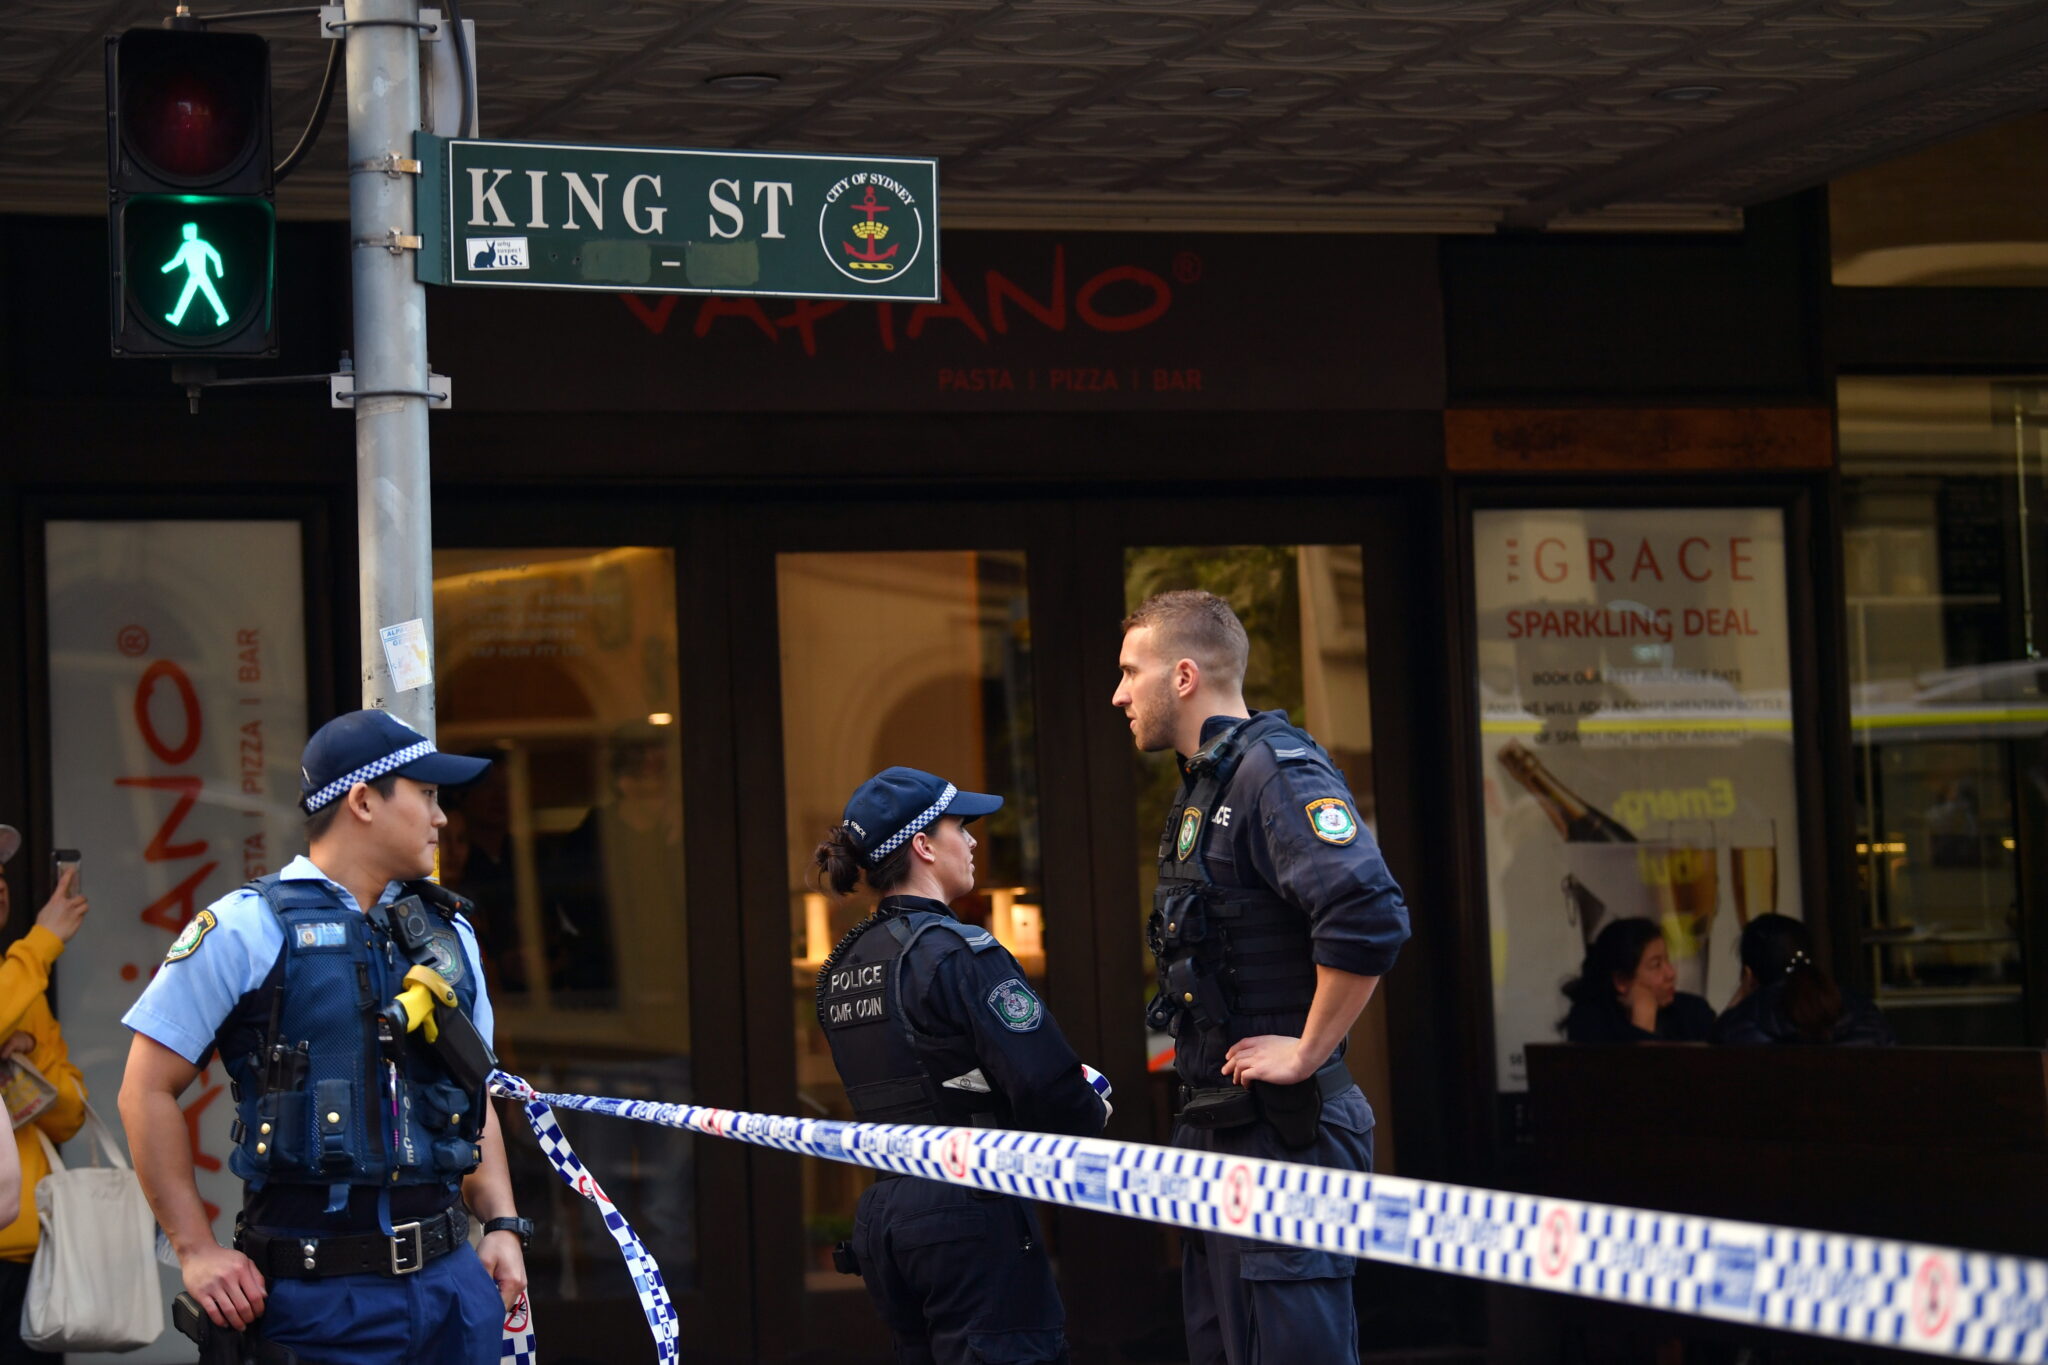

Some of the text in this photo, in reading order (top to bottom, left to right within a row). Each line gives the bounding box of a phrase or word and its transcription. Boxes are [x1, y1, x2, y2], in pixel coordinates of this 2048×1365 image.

[466, 168, 793, 239] KING ST
[826, 172, 915, 206] CITY OF SYDNEY
[499, 254, 523, 266] us.
[938, 368, 1202, 392] PASTA PIZZA BAR
[1507, 536, 1755, 583] THE GRACE
[1506, 609, 1758, 642] SPARKLING DEAL
[238, 629, 267, 880] STA PIZZA BAR
[831, 965, 882, 993] POLICE
[856, 996, 883, 1018] ODIN
